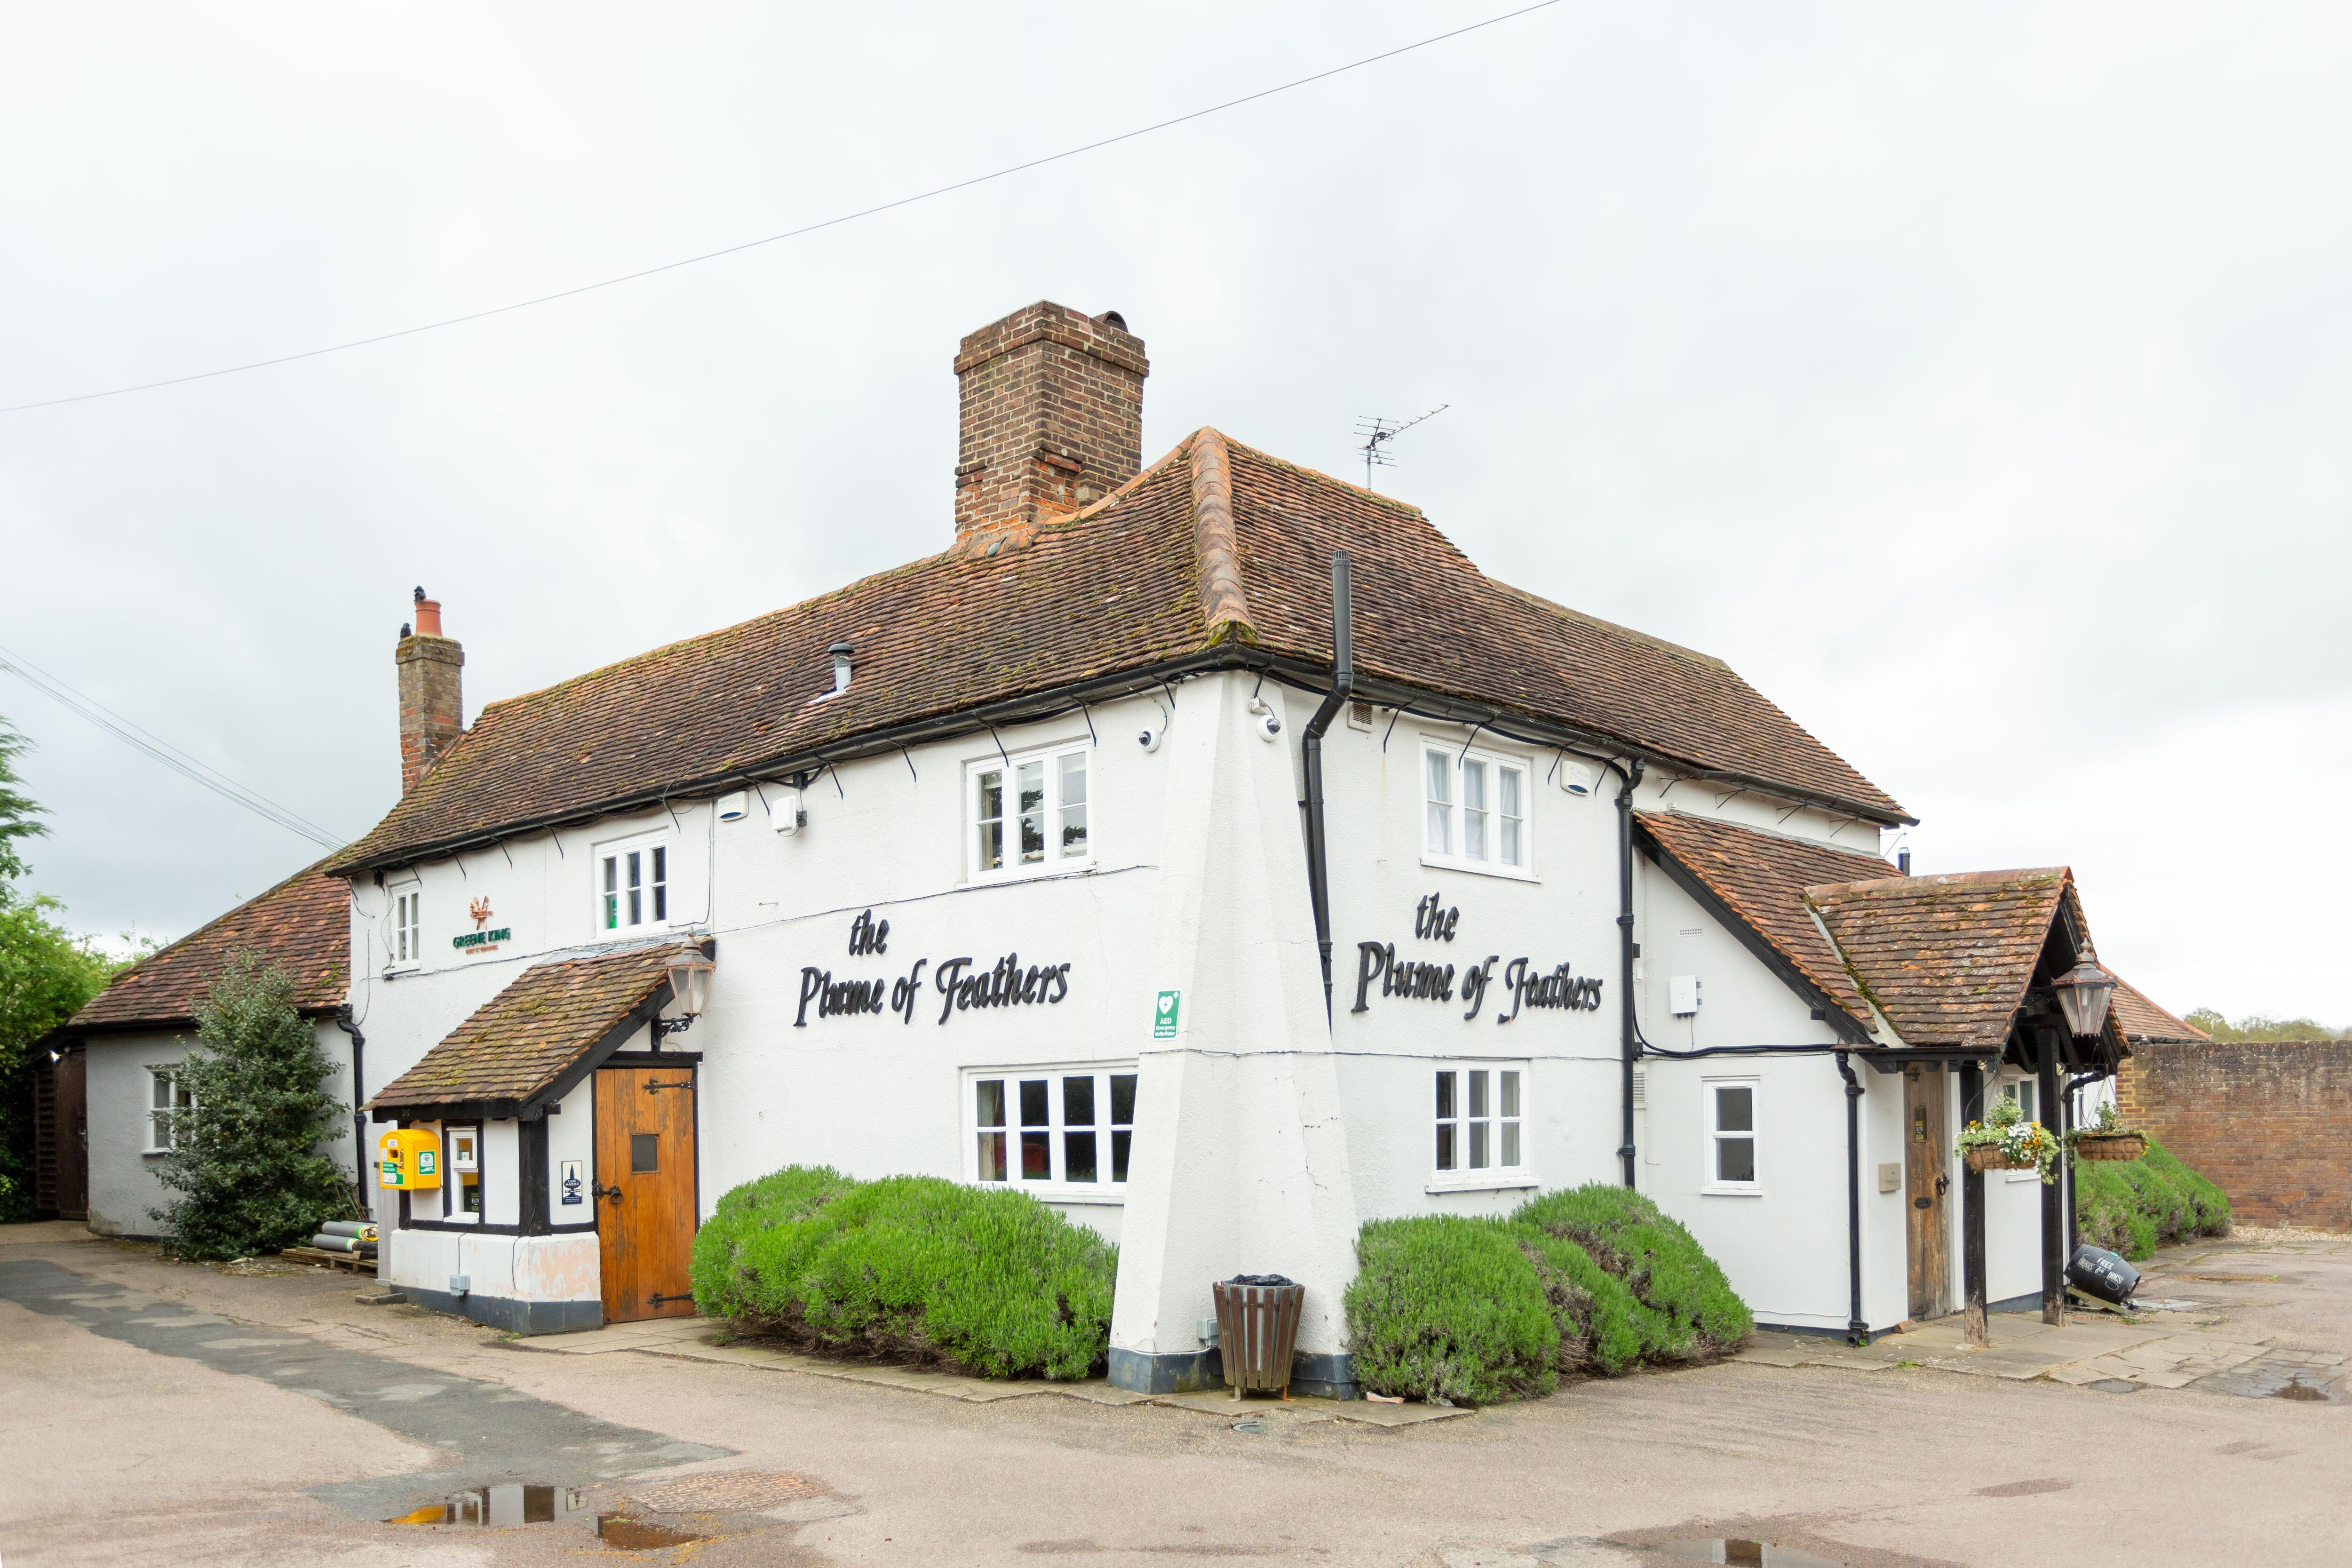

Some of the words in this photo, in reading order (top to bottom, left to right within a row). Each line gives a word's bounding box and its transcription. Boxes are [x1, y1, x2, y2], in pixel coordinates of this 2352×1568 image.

[453, 931, 486, 948] GREENE
[488, 927, 511, 941] KING
[849, 909, 889, 955] the
[1415, 891, 1459, 941] the
[793, 967, 884, 1027] Plume
[892, 958, 927, 1025] of
[936, 952, 1071, 1026] Feathers
[1351, 941, 1454, 1012] Plume
[1461, 955, 1499, 1019] of
[1497, 957, 1603, 1023] Feathers
[2077, 1257, 2093, 1271] DRINKS
[2106, 1272, 2123, 1284] DOGS
[2097, 1258, 2114, 1270] FREE
